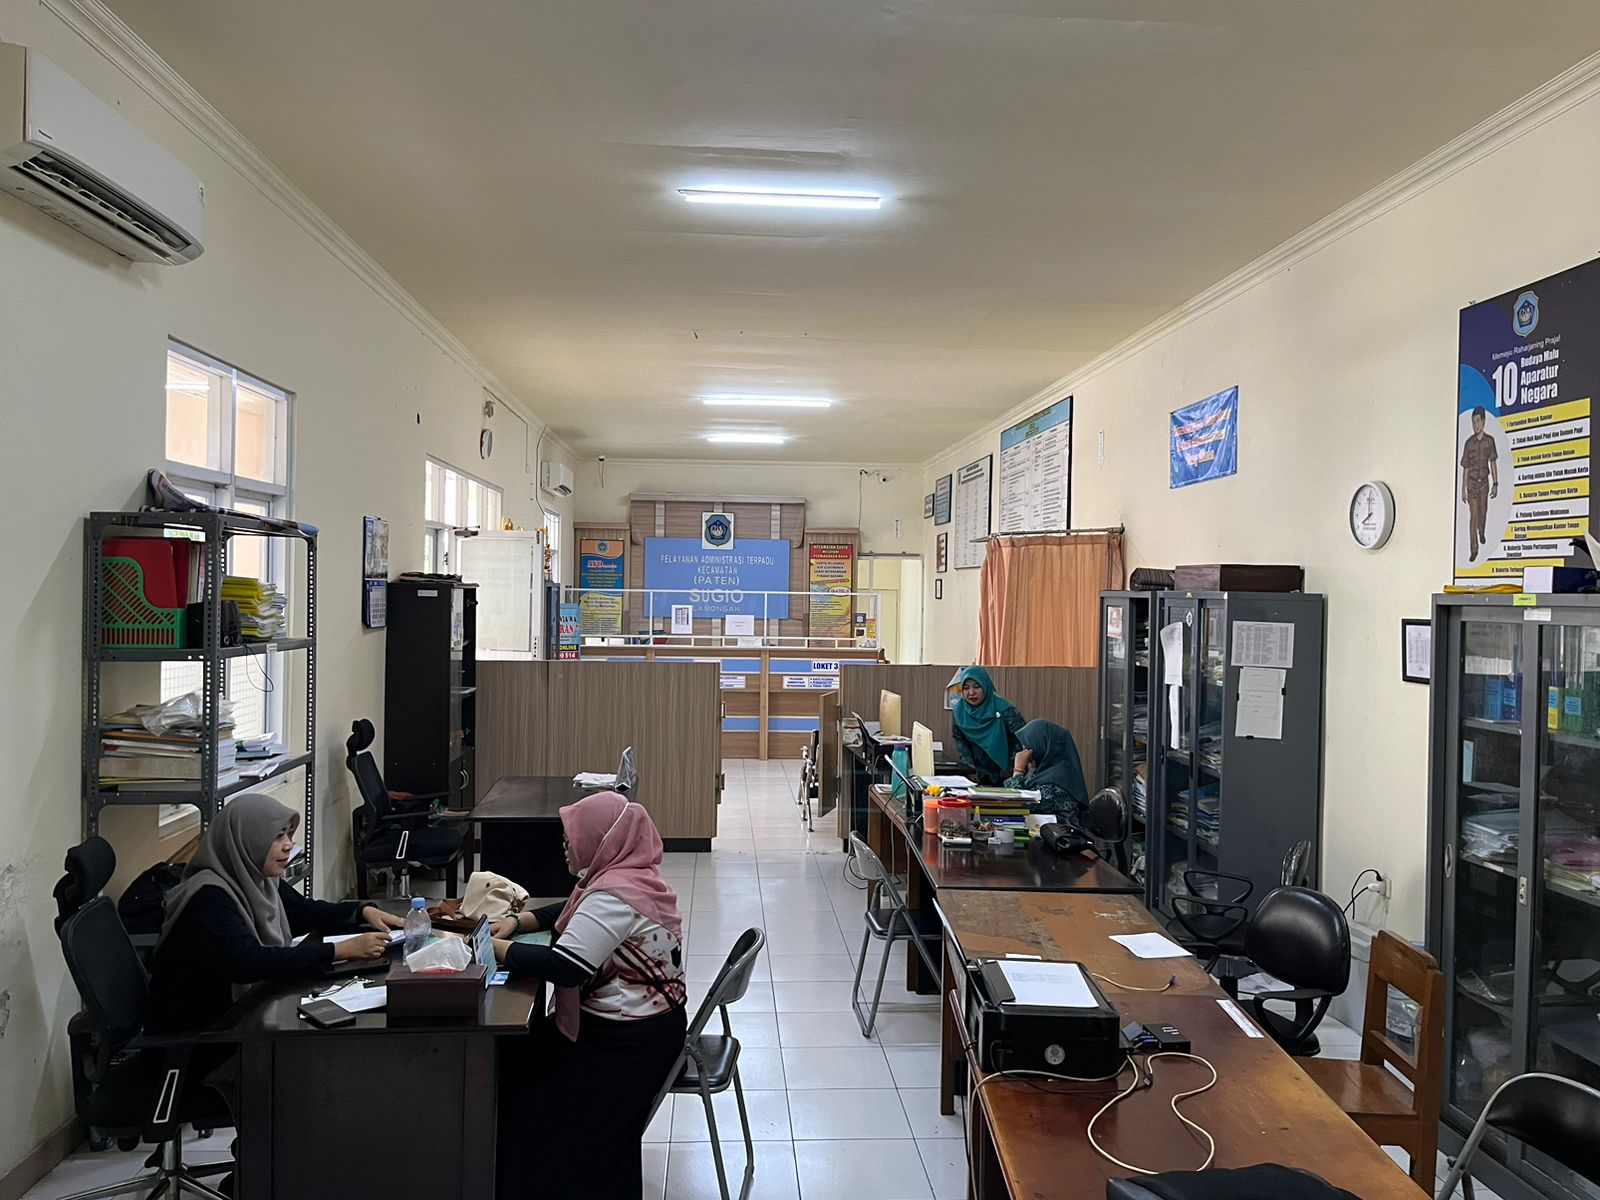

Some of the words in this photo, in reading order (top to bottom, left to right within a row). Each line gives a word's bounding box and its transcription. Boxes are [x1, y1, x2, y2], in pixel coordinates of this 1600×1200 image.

[1492, 350, 1512, 360] Memayu
[1520, 354, 1542, 367] Budaya
[1544, 349, 1559, 361] Malu
[1520, 365, 1559, 386] Aparatur
[1492, 362, 1518, 408] 10
[1520, 383, 1558, 404] Negara
[660, 554, 698, 564] PELAYANAN
[700, 555, 744, 565] ADMINISTRASI
[746, 556, 774, 565] TERPADU
[698, 566, 738, 575] KECAMATAN
[689, 588, 744, 603] SUGIO
